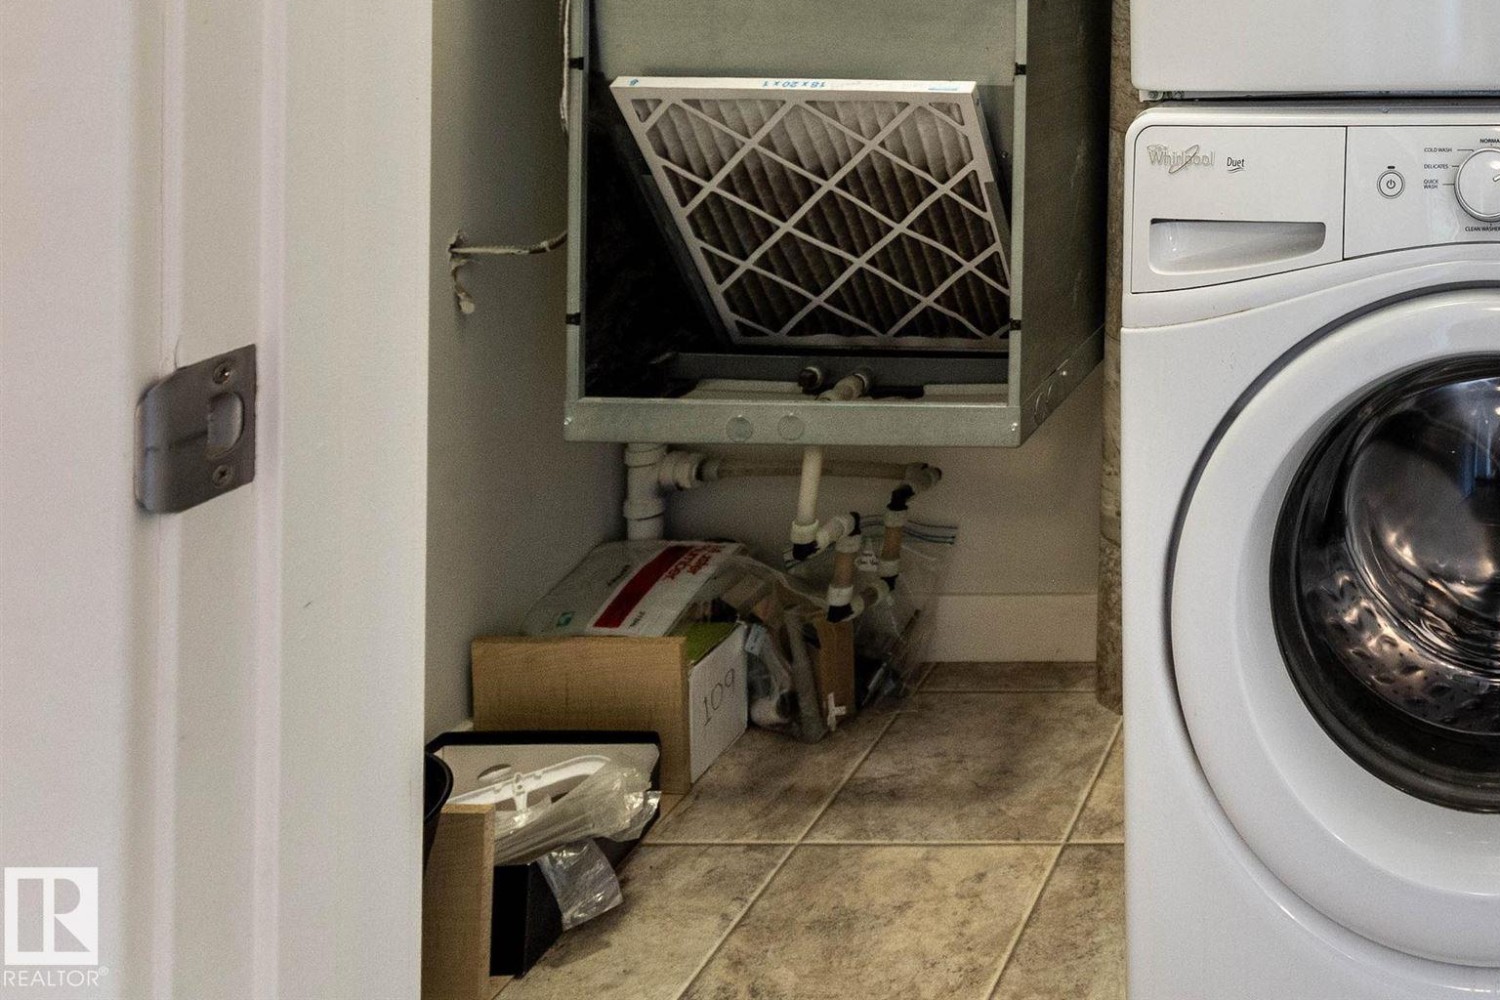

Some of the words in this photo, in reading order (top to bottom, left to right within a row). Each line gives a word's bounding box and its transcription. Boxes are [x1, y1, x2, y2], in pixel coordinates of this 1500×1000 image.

[1147, 145, 1216, 174] Whirlpool
[1226, 157, 1245, 168] Duet
[703, 667, 735, 727] 109
